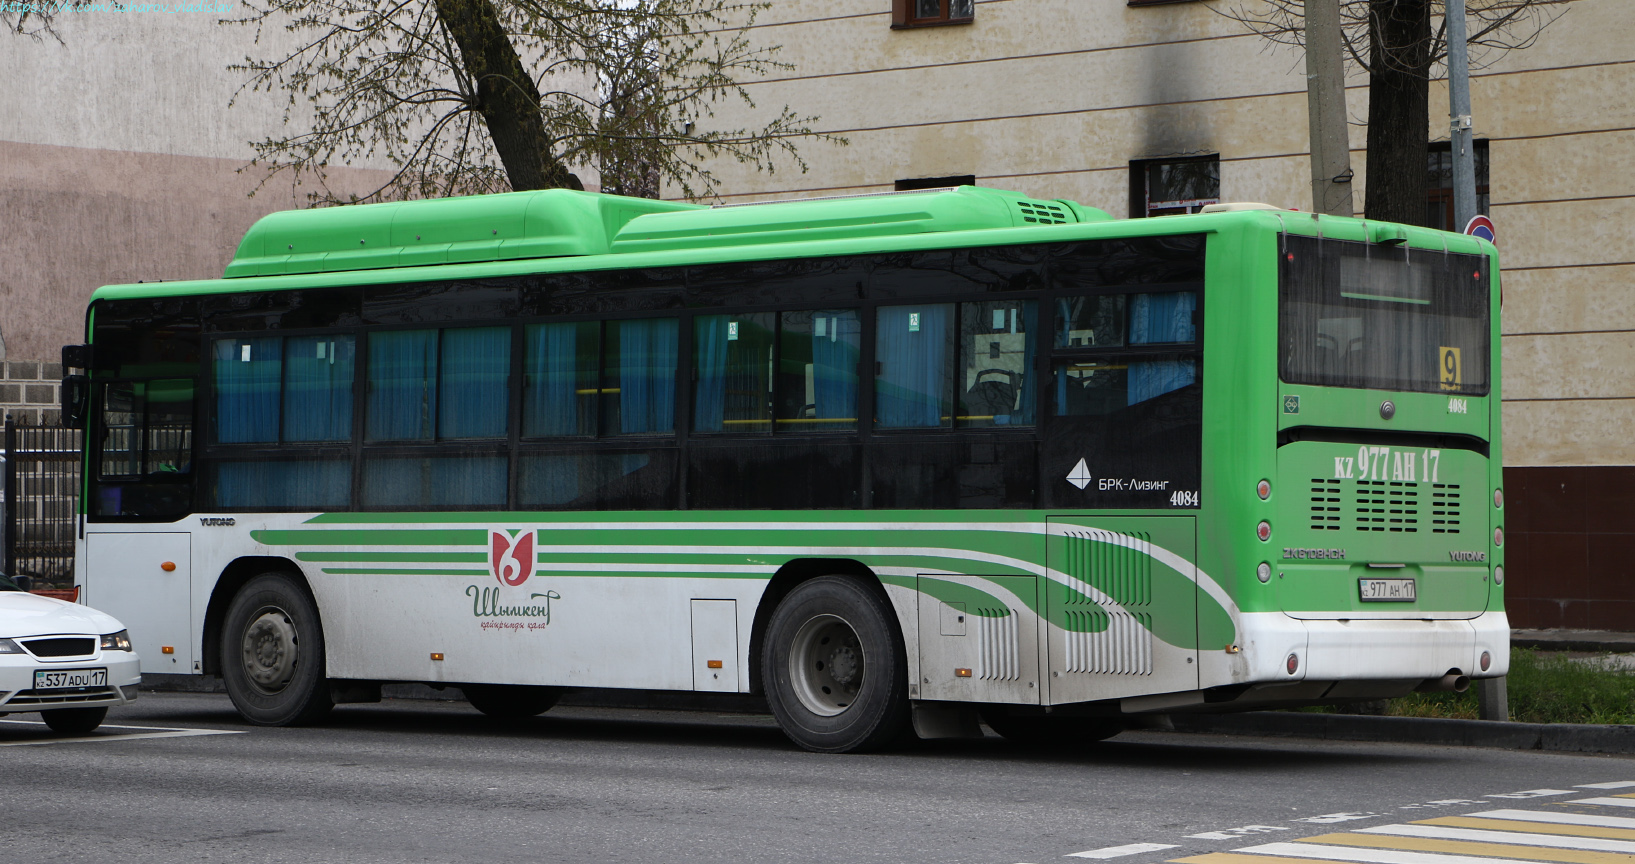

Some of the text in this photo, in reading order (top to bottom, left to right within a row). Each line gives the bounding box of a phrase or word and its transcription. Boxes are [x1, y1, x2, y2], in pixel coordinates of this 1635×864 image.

[1444, 349, 1458, 388] 9
[1448, 398, 1467, 414] 4084
[1334, 446, 1440, 483] KZ 977 AH 17
[1098, 478, 1170, 491] БРК-Лизинг
[1169, 490, 1199, 507] 4084
[199, 517, 236, 527] YUTONG
[1448, 551, 1487, 562] YUTONG
[1370, 581, 1387, 597] 977
[1389, 584, 1401, 597] AH
[1403, 581, 1414, 597] 17
[465, 584, 561, 626] Шымкент
[46, 672, 67, 687] 537
[68, 675, 89, 686] ADU
[92, 671, 105, 685] 17
